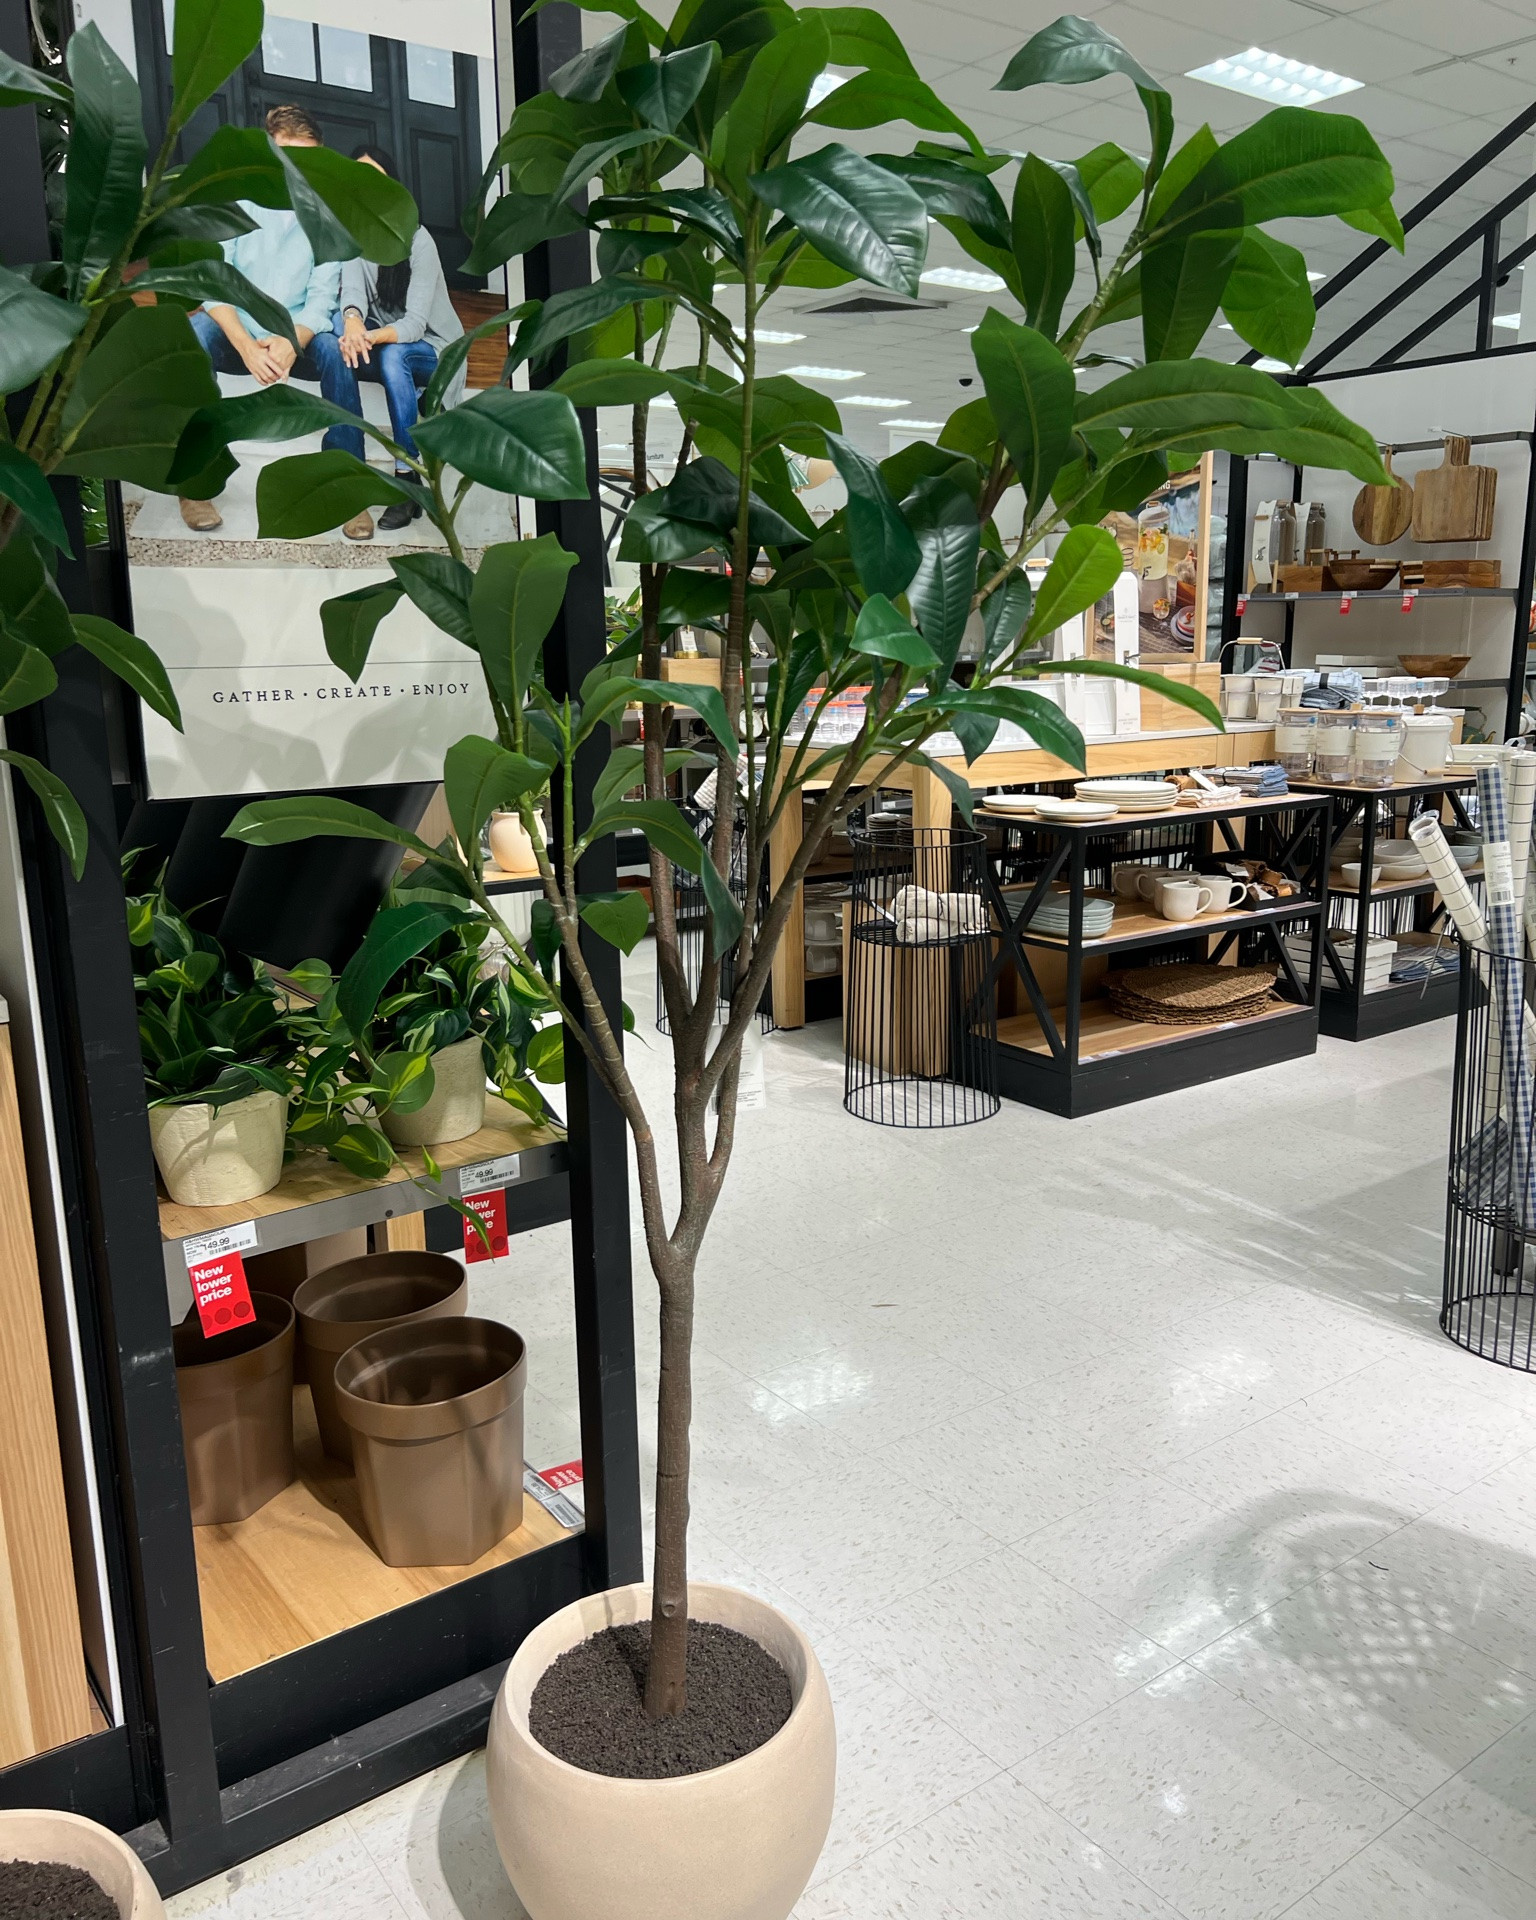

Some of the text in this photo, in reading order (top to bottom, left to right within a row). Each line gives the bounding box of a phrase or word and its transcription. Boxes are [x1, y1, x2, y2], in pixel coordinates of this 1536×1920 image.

[213, 683, 471, 703] GATHER CREATE ENJOY
[475, 1168, 494, 1178] 49.99
[465, 1200, 490, 1210] New
[466, 1209, 496, 1223] wer
[194, 1265, 224, 1282] New
[196, 1274, 233, 1293] lower
[199, 1286, 232, 1307] price
